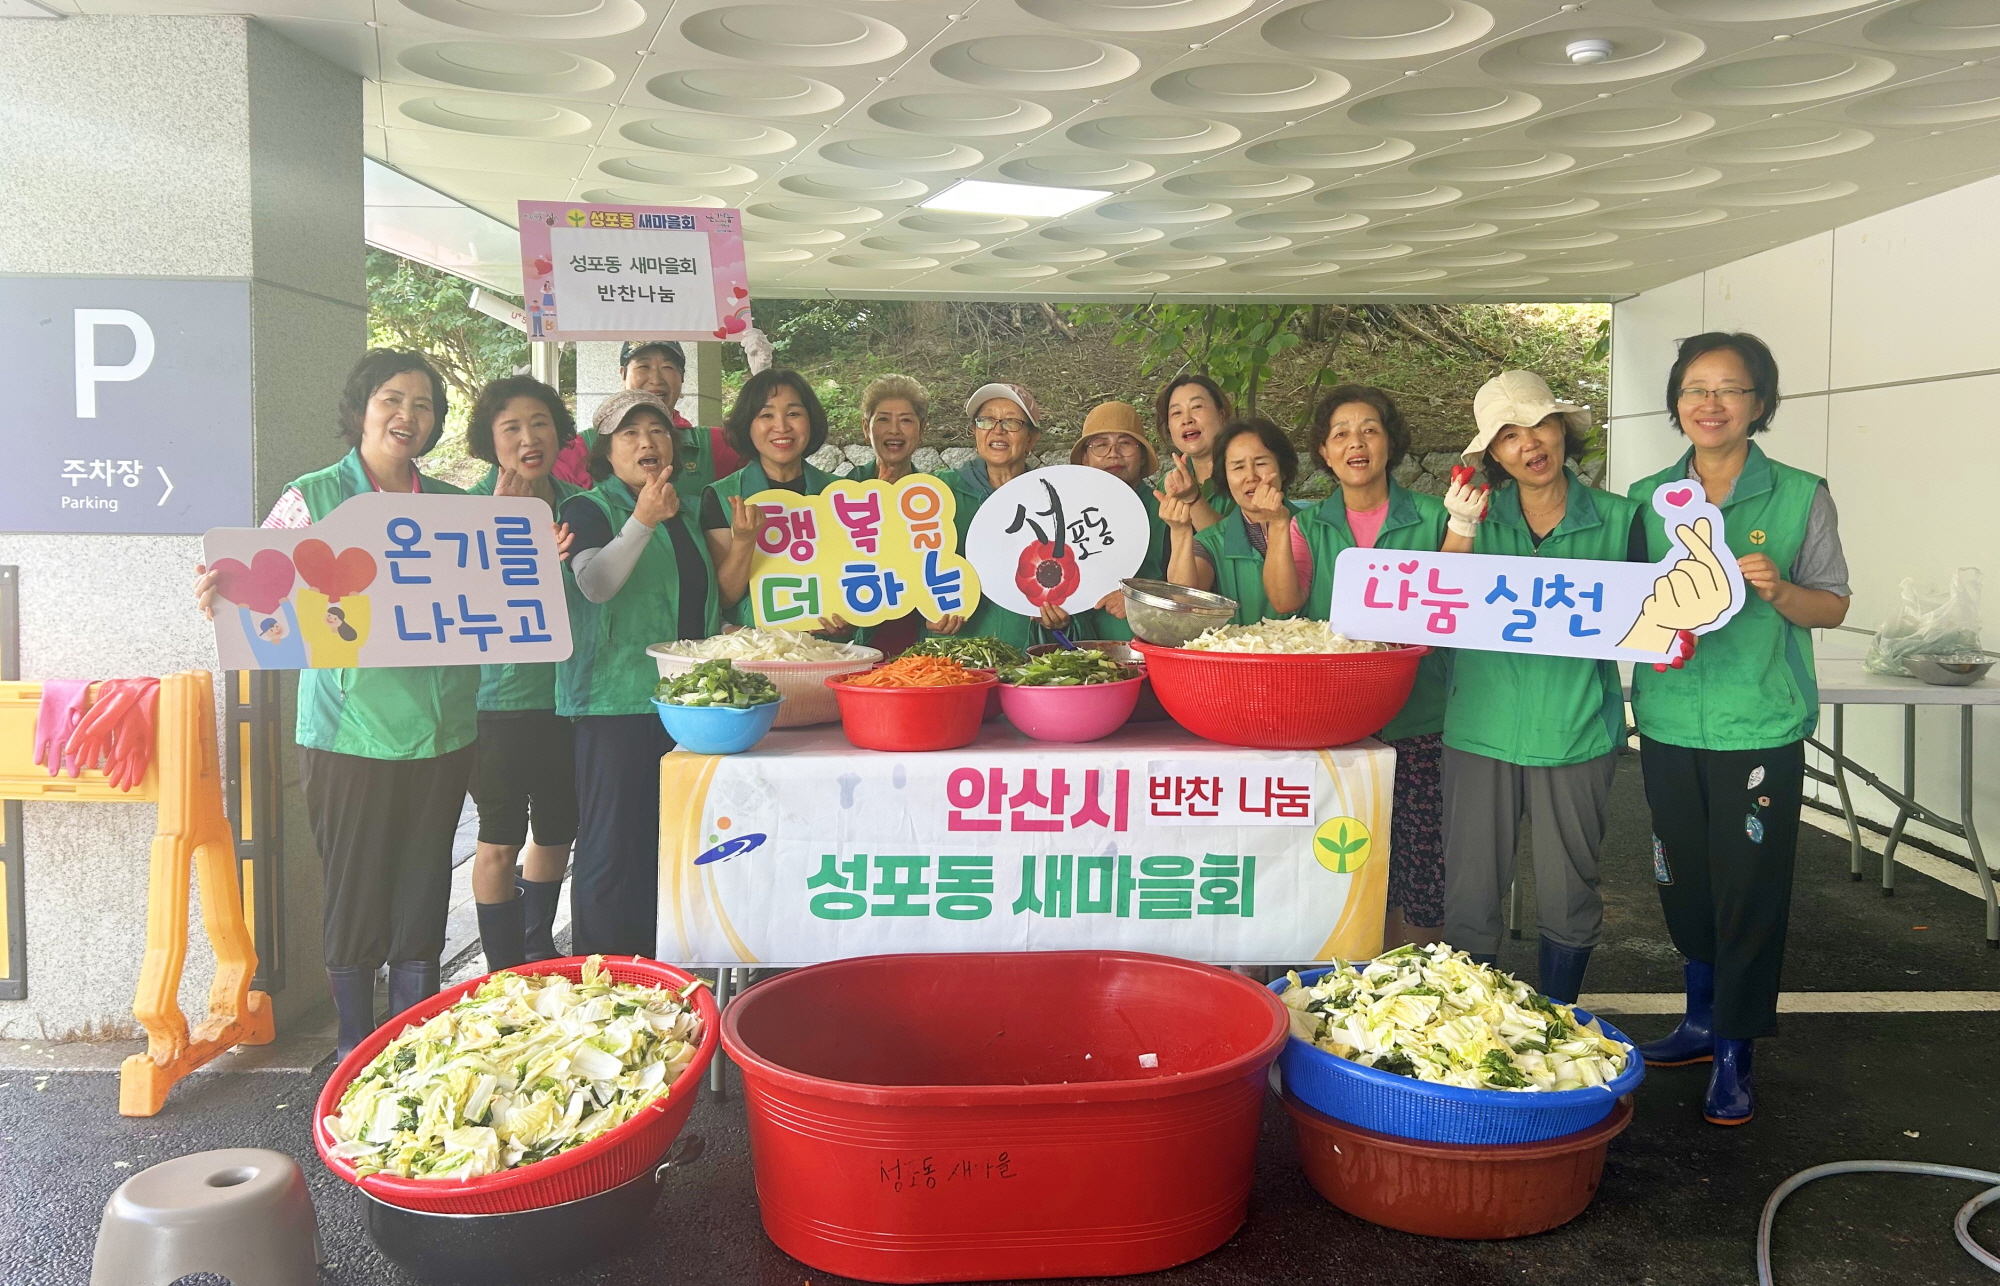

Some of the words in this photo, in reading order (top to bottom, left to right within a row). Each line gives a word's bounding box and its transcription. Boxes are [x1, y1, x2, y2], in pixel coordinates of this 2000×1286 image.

[590, 210, 635, 229] 성포동
[638, 213, 697, 230] 새마을회
[569, 255, 622, 274] 성포동
[629, 257, 697, 276] 새마을회
[597, 284, 676, 304] 반찬나눔
[74, 308, 155, 419] P
[61, 459, 144, 488] 주차장
[61, 496, 119, 512] Parking
[384, 516, 539, 586] 온기를
[755, 485, 942, 562] 행복을
[761, 550, 963, 624] 더하는
[1363, 561, 1470, 635] 나눔
[1484, 573, 1604, 643] 실천
[394, 594, 553, 652] 나누고
[946, 767, 1130, 833] 안산시
[1147, 775, 1224, 817] 반찬
[1238, 775, 1312, 819] 나눔
[806, 852, 994, 921] 성포동
[1012, 852, 1257, 921] 새마을회
